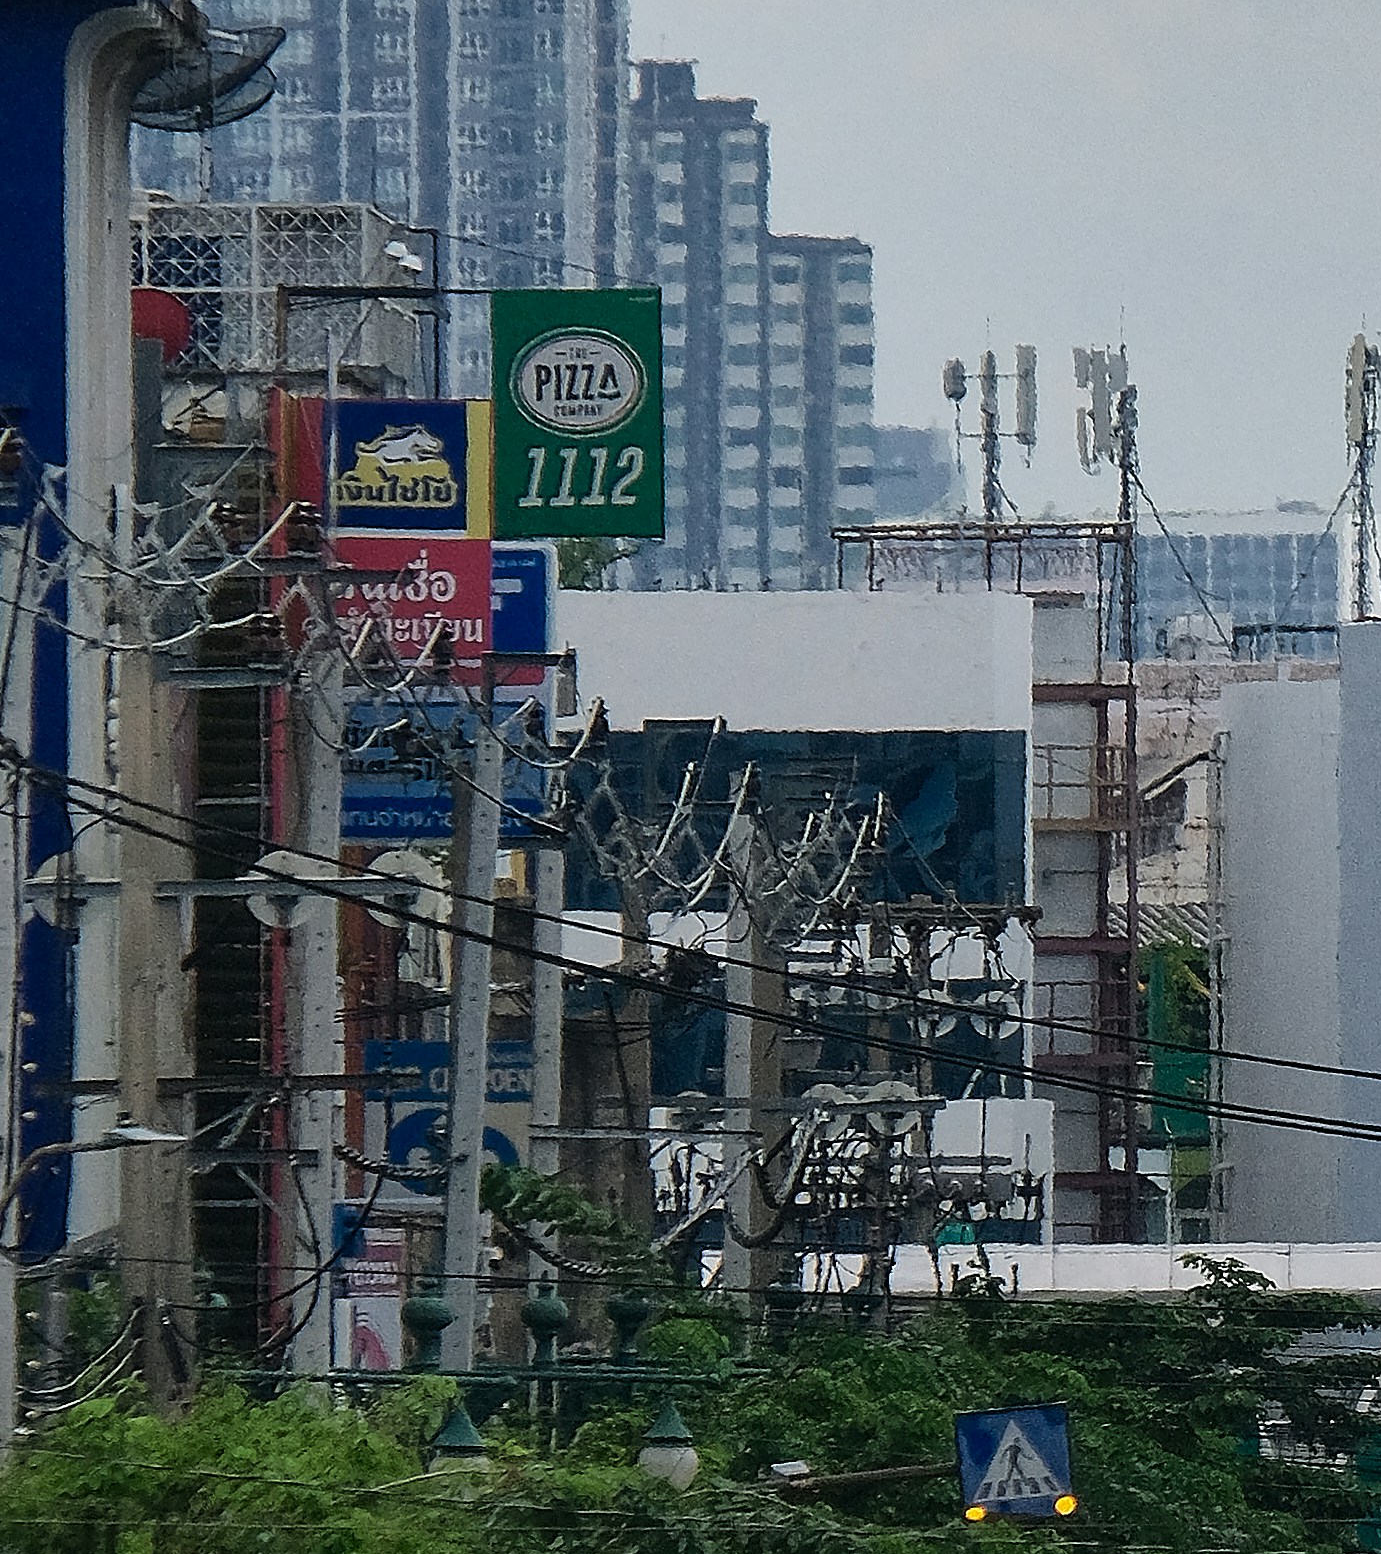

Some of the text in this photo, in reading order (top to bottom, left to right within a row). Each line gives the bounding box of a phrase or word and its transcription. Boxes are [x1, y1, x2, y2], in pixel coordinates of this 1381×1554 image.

[534, 363, 621, 402] PIZZA
[553, 403, 604, 418] COMPANY
[518, 446, 645, 508] 1112
